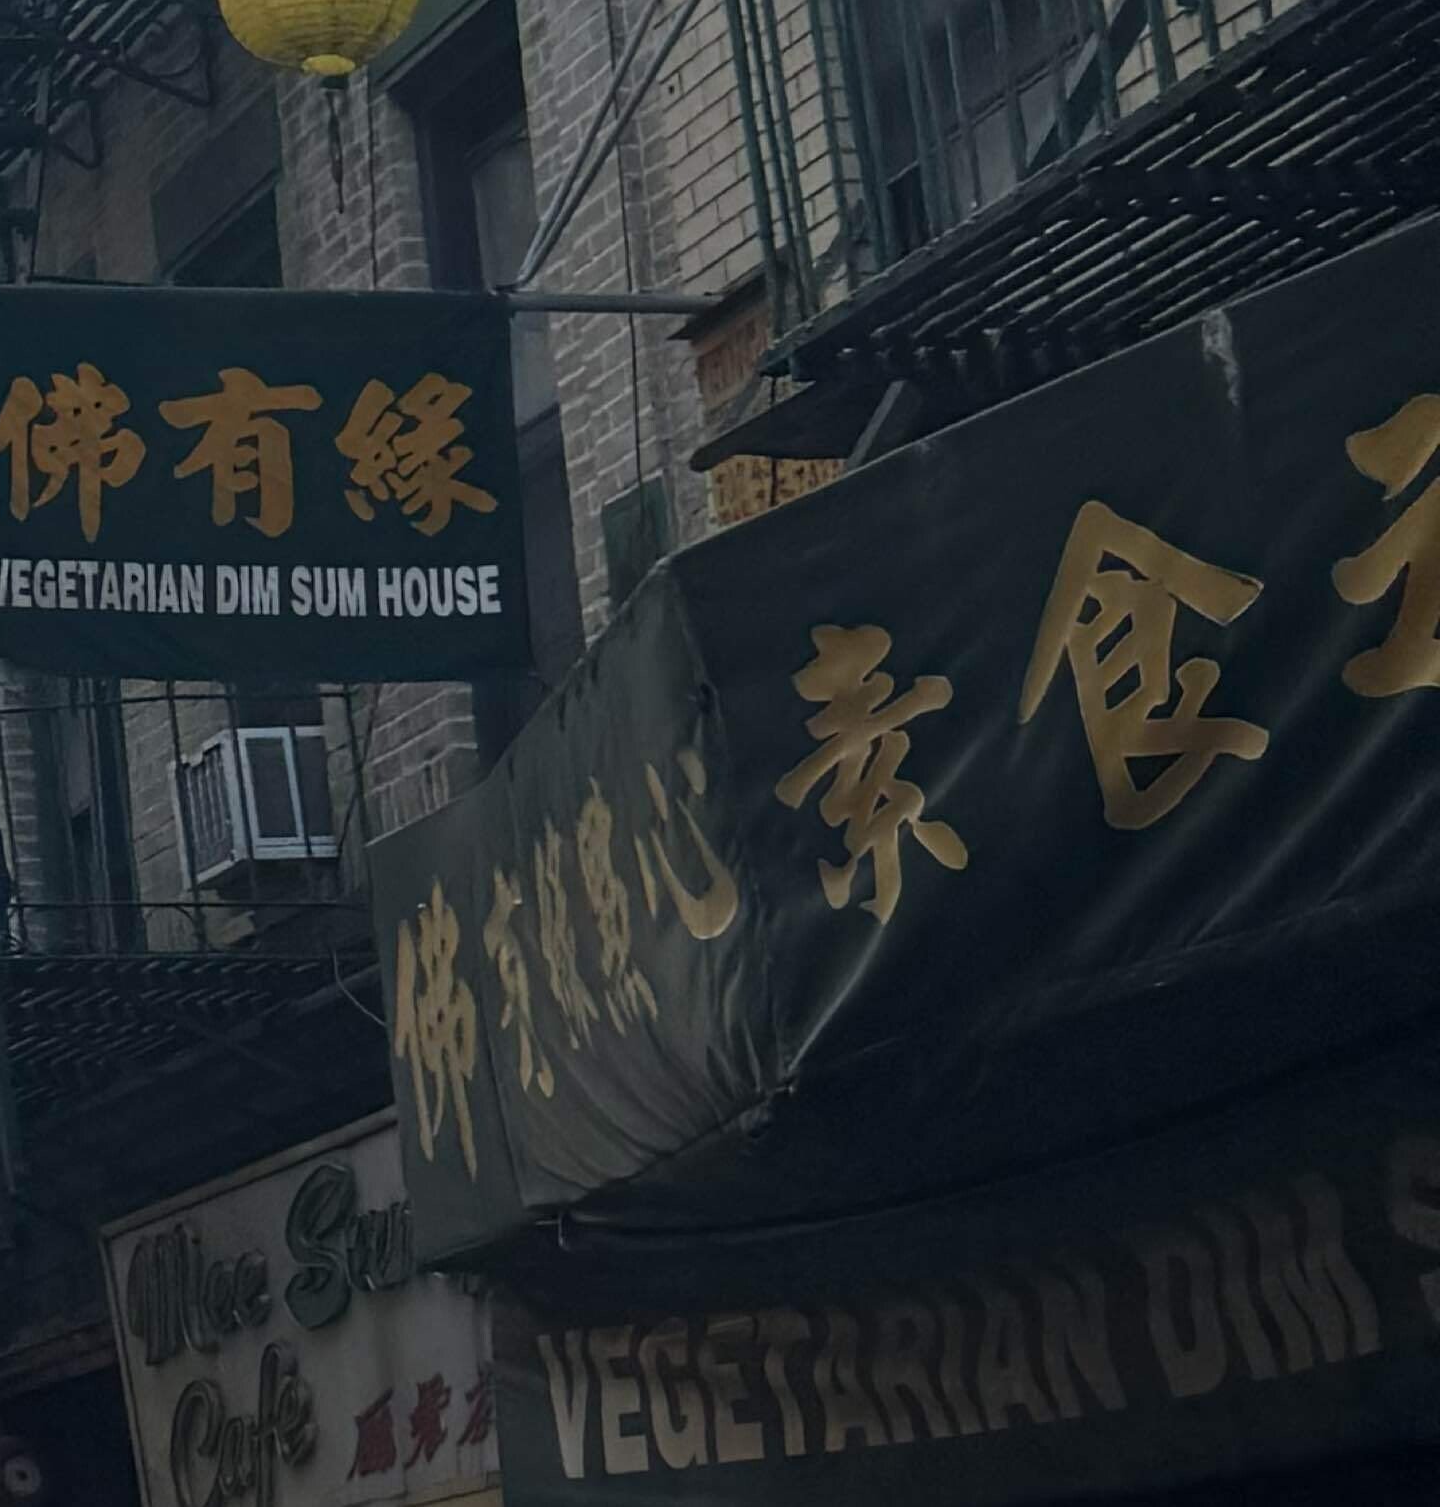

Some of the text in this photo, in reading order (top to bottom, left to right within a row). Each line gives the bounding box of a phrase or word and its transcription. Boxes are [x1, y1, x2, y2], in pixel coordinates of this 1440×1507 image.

[216, 566, 280, 616] DIM
[291, 566, 367, 618] SUM
[378, 565, 503, 618] HOUSE
[538, 1252, 1128, 1479] VEGETARIAN
[1138, 1170, 1383, 1399] DIM
